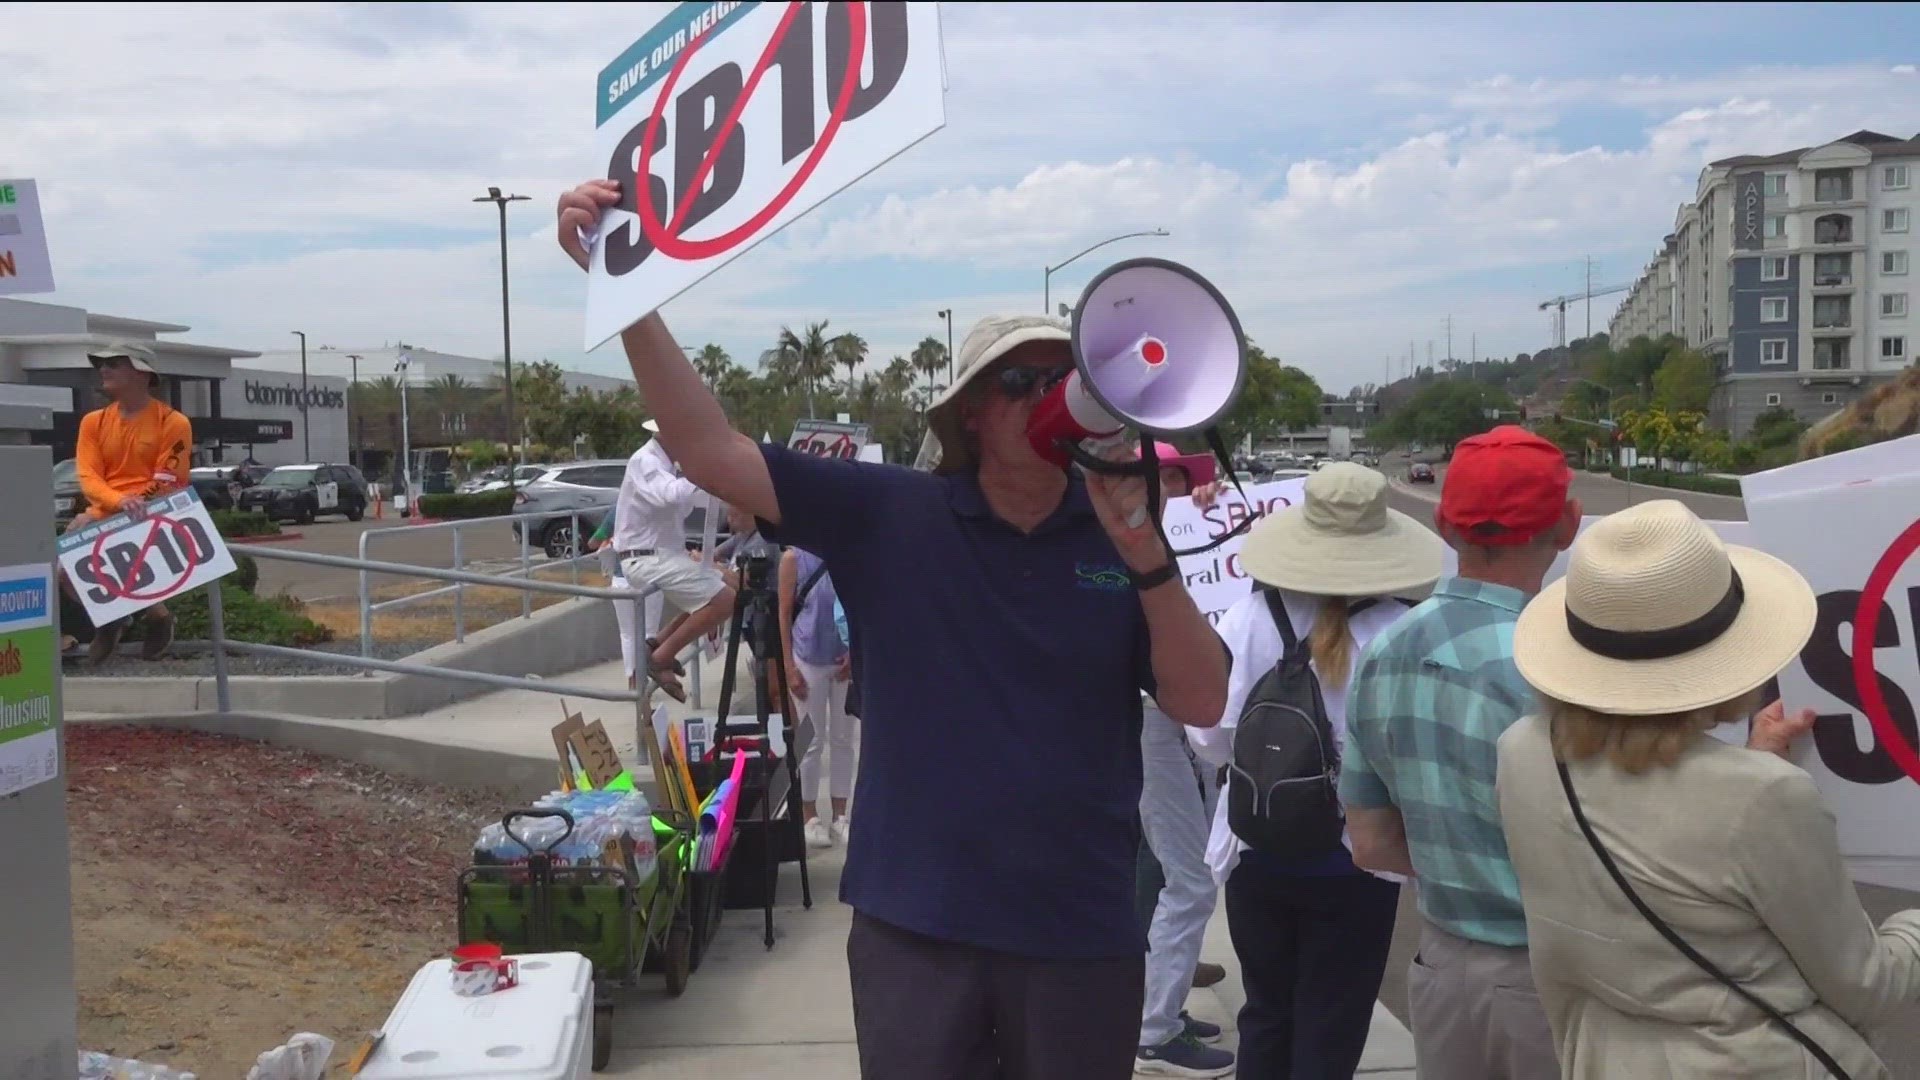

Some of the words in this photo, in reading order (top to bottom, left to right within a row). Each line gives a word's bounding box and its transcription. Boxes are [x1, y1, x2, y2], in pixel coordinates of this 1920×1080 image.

[608, 56, 648, 104] SAVE
[651, 28, 686, 70] OUR
[1744, 182, 1758, 240] APEX
[74, 517, 216, 604] SB10
[1799, 584, 1920, 785] S
